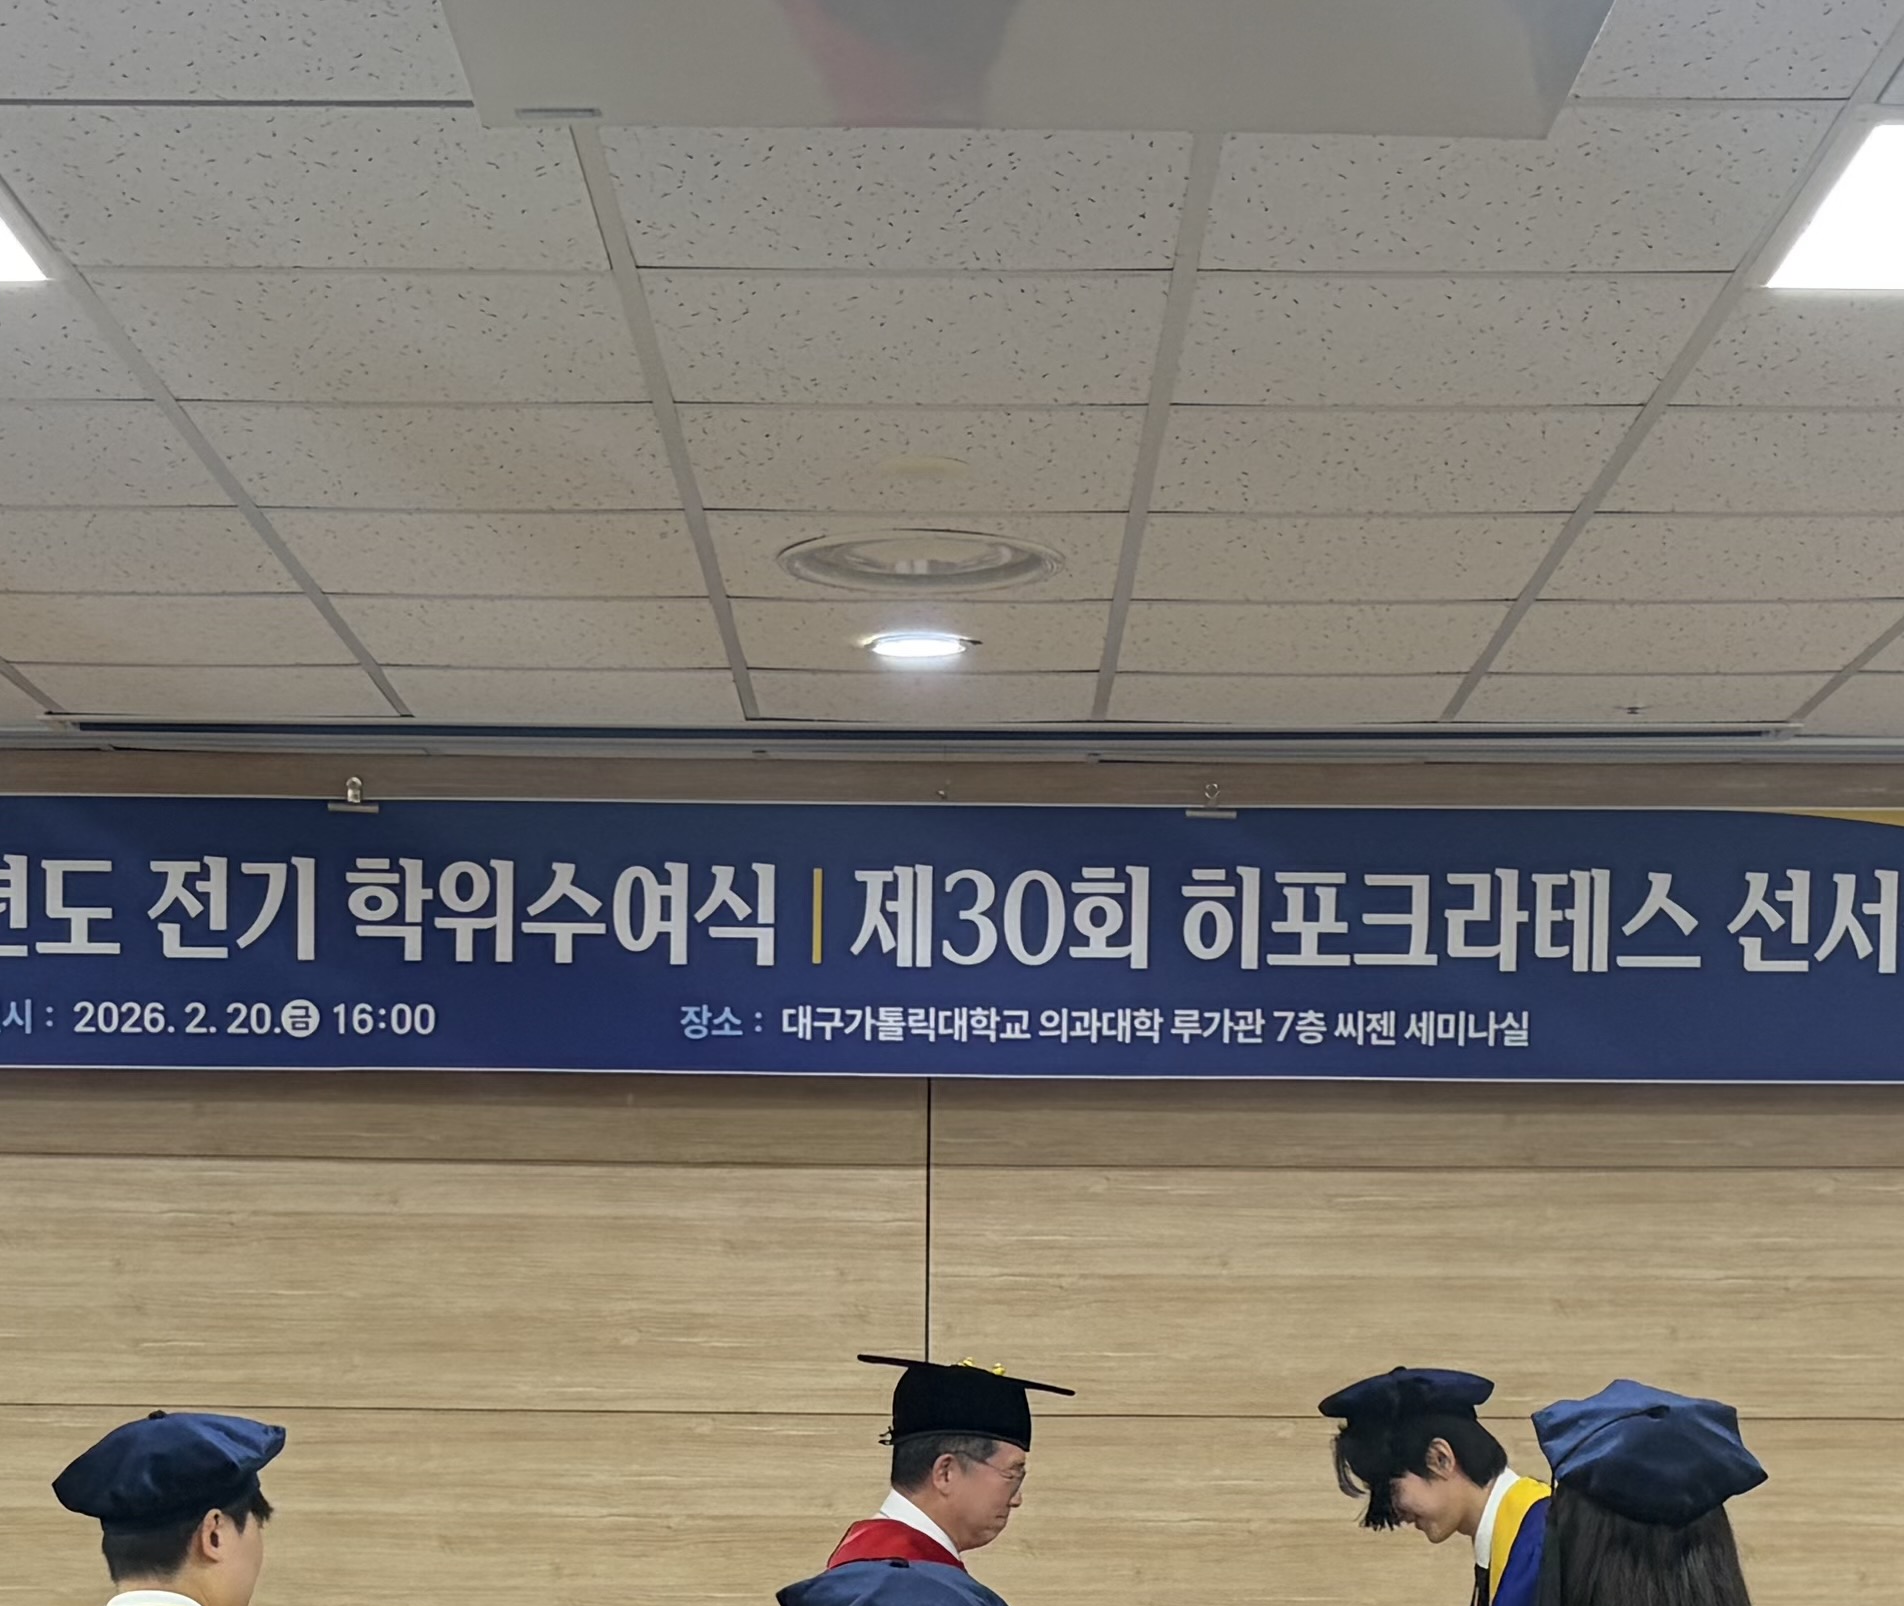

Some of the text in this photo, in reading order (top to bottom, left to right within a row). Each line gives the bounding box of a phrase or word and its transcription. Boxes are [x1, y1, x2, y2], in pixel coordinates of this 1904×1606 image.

[147, 855, 315, 961] 전기
[345, 857, 776, 966] 학위수여식
[850, 864, 1150, 969] 제30회
[1181, 865, 1702, 973] 히포크라테스
[73, 1001, 175, 1033] 2026.
[333, 1002, 435, 1035] 16:00
[782, 1005, 1032, 1043] 대구가톨릭대학교
[1038, 1007, 1164, 1044] 의과대학
[1170, 1008, 1266, 1044] 루가관
[1273, 1009, 1328, 1045] 7층
[1333, 1010, 1396, 1046] 씨젠
[1404, 1010, 1529, 1047] 세미나실
